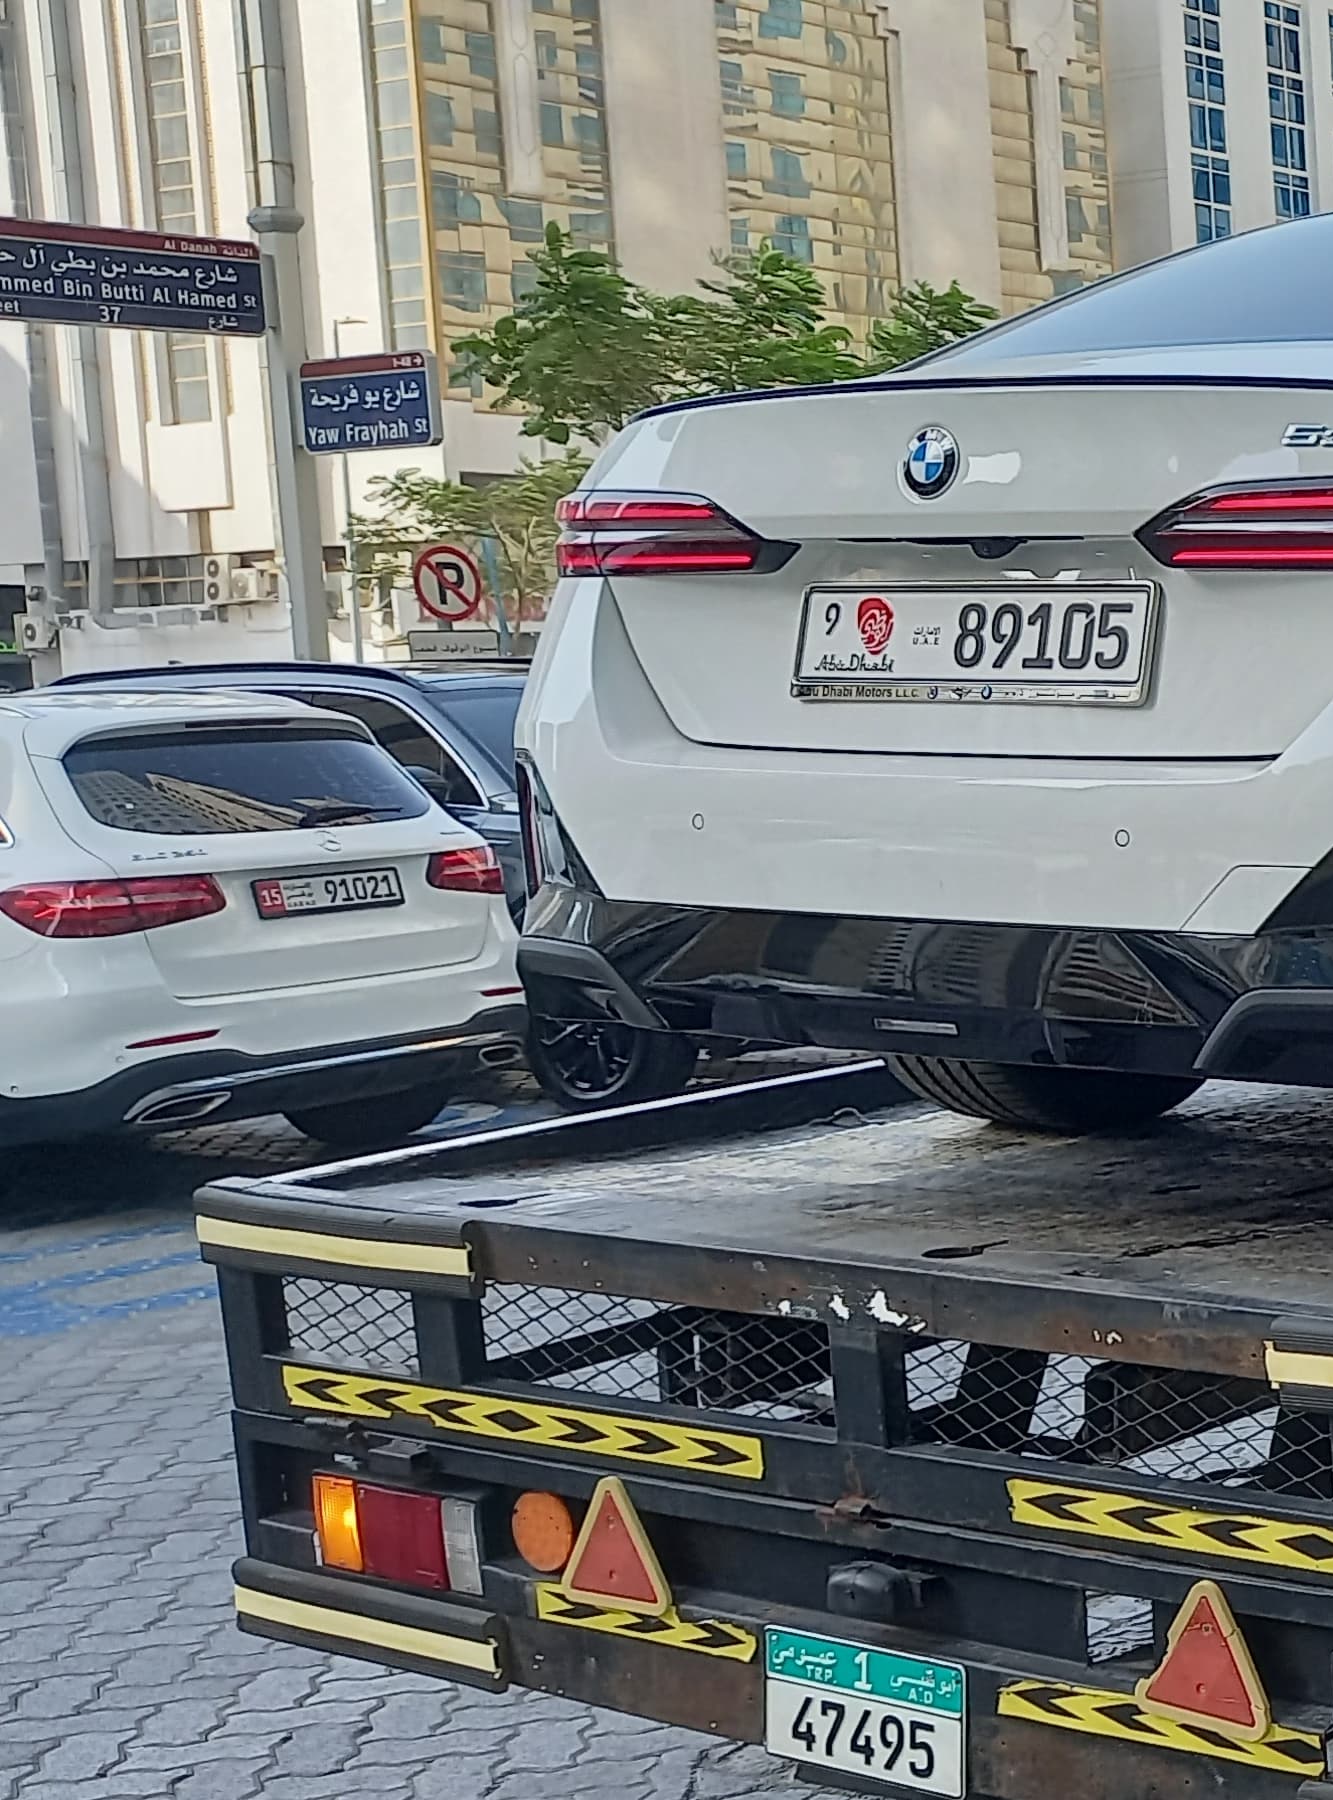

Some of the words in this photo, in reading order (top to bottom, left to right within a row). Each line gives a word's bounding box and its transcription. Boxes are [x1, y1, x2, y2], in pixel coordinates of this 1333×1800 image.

[22, 244, 45, 268] آل
[164, 240, 176, 250] Al
[180, 241, 217, 254] Danah
[51, 250, 97, 276] بطي
[101, 256, 127, 278] بن
[133, 263, 190, 277] محمد
[194, 264, 238, 289] شارع
[63, 280, 93, 297] Bin
[101, 283, 144, 301] Butti
[152, 287, 171, 303] Al
[177, 289, 237, 309] Hamed
[243, 295, 257, 307] St
[99, 305, 122, 323] 37
[208, 315, 238, 331] شارع
[383, 380, 420, 411] شارع
[307, 426, 340, 445] Yaw
[345, 418, 409, 446] Frayhah
[414, 418, 428, 433] St
[825, 602, 841, 635] 9
[953, 601, 1135, 670] 89105
[822, 686, 852, 697] Dhabi
[855, 686, 892, 698] Motors
[261, 888, 281, 906] 15
[324, 875, 397, 903] 91021
[853, 1651, 873, 1691] 1
[792, 1696, 936, 1779] 47495
